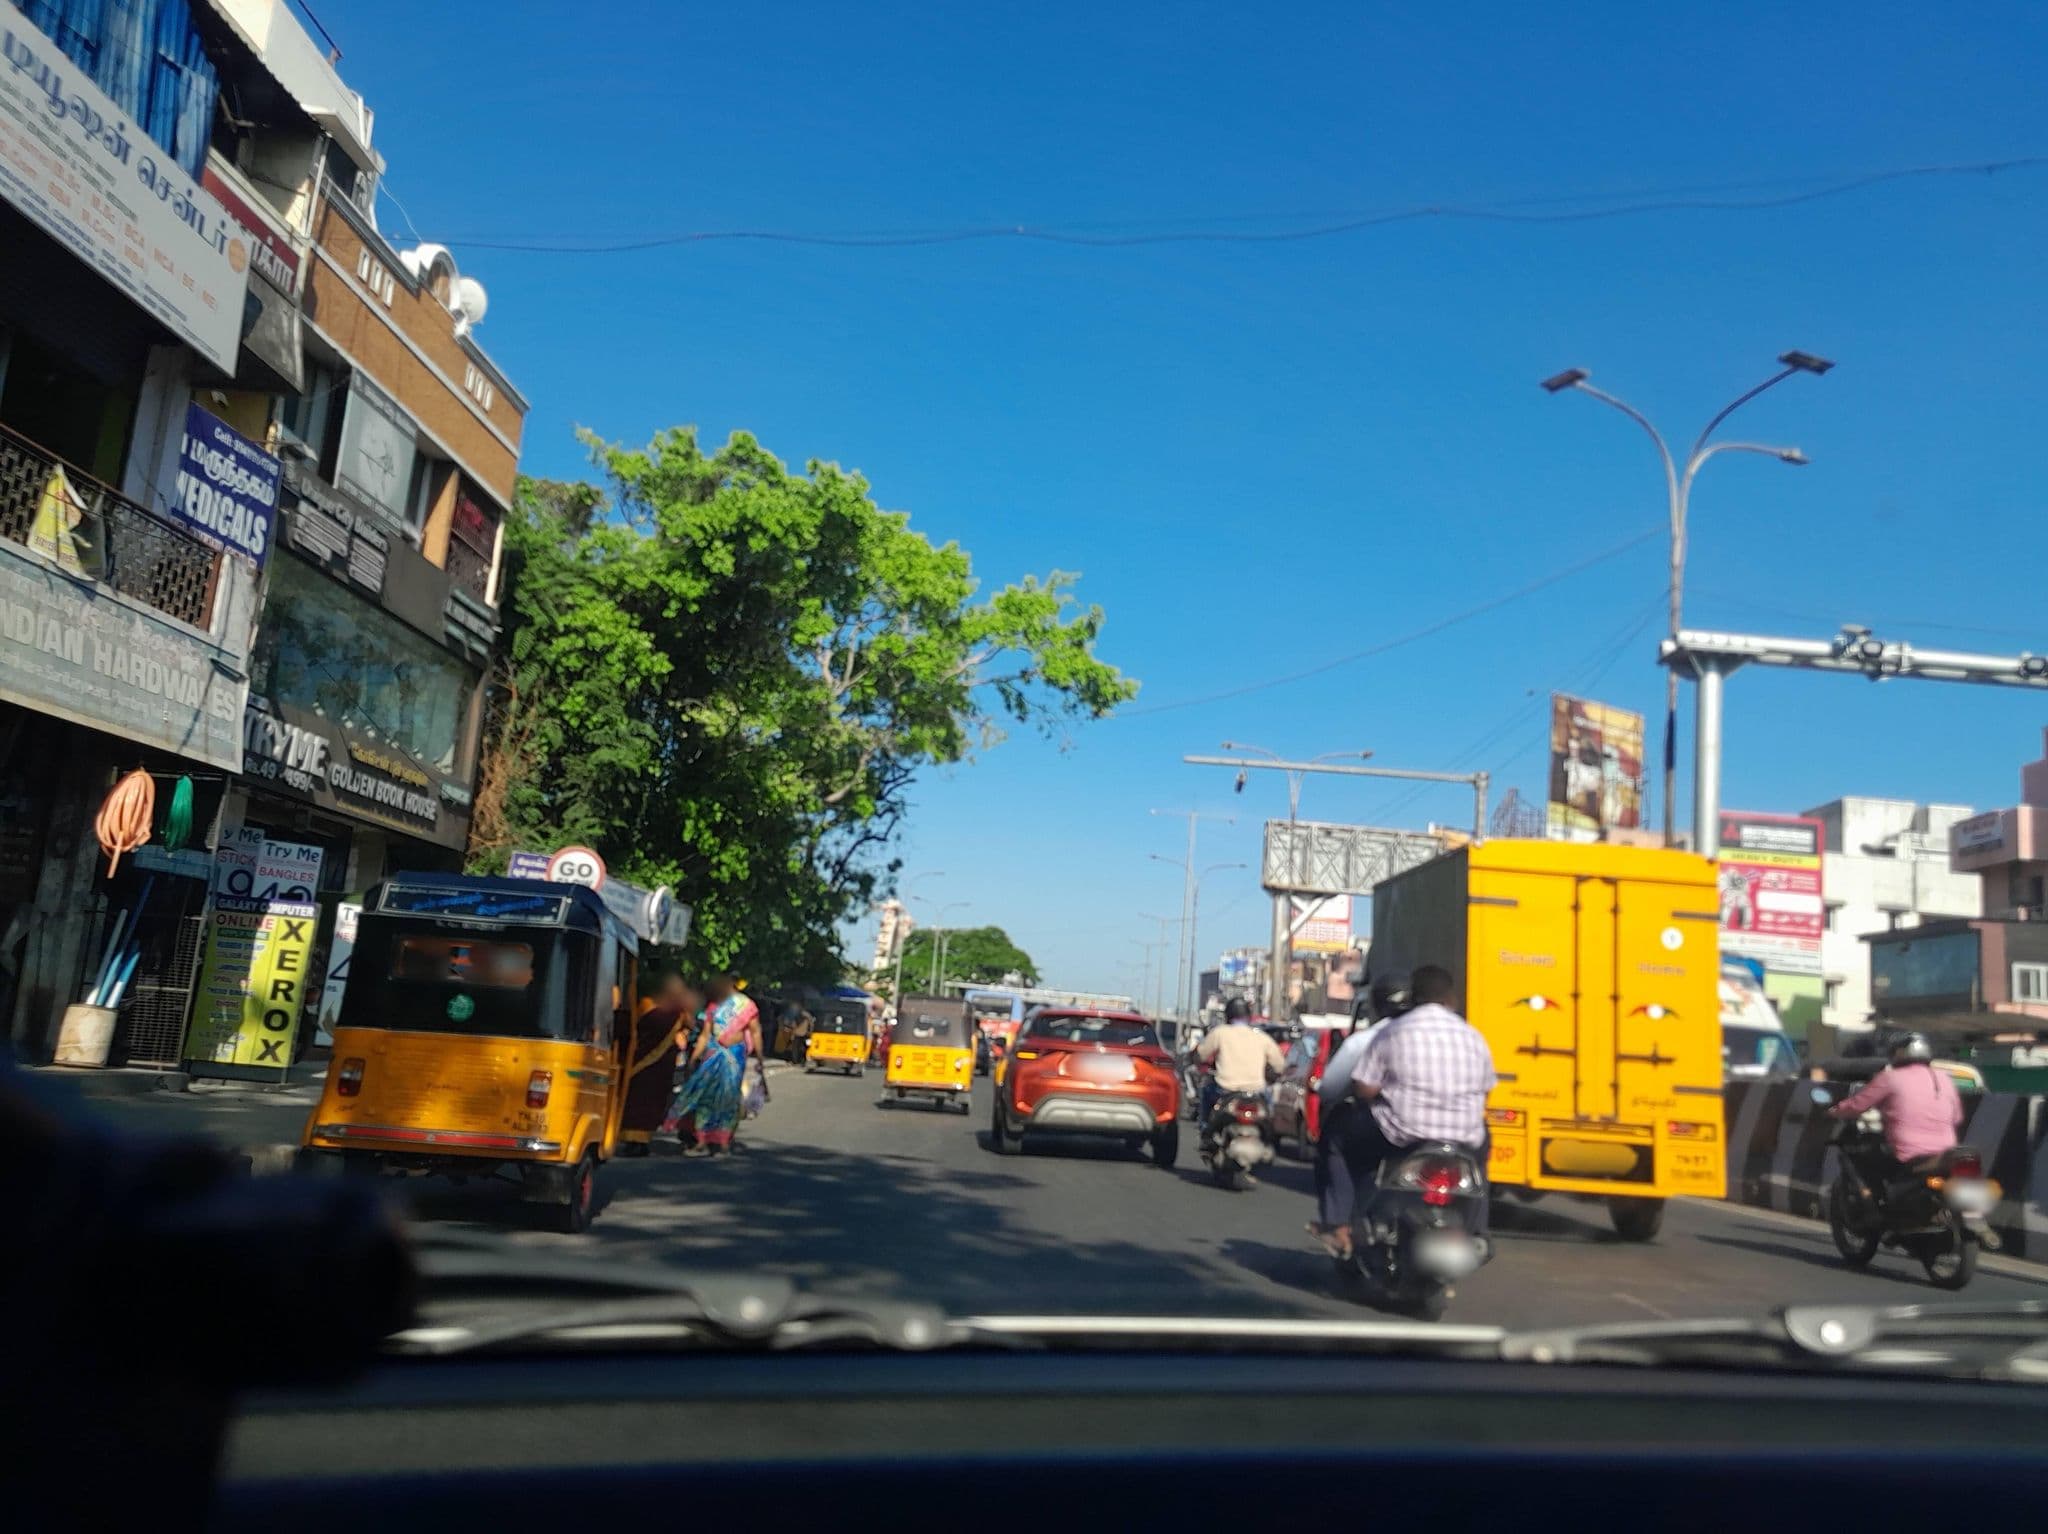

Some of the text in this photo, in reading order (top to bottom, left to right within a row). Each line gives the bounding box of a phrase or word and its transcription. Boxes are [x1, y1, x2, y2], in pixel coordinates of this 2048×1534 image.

[137, 153, 229, 256] சென்டர்
[94, 636, 235, 722] HARDWAES
[330, 761, 375, 799] GOLDEN
[375, 779, 406, 810] BOOK
[405, 791, 436, 821] HOUSE
[238, 829, 262, 844] Me
[266, 842, 320, 862] Try Me
[258, 866, 315, 882] BANGLES
[559, 861, 593, 878] GO
[260, 902, 316, 917] COMPUTER
[215, 914, 274, 930] ONLINE
[255, 919, 307, 1063] XEROX
